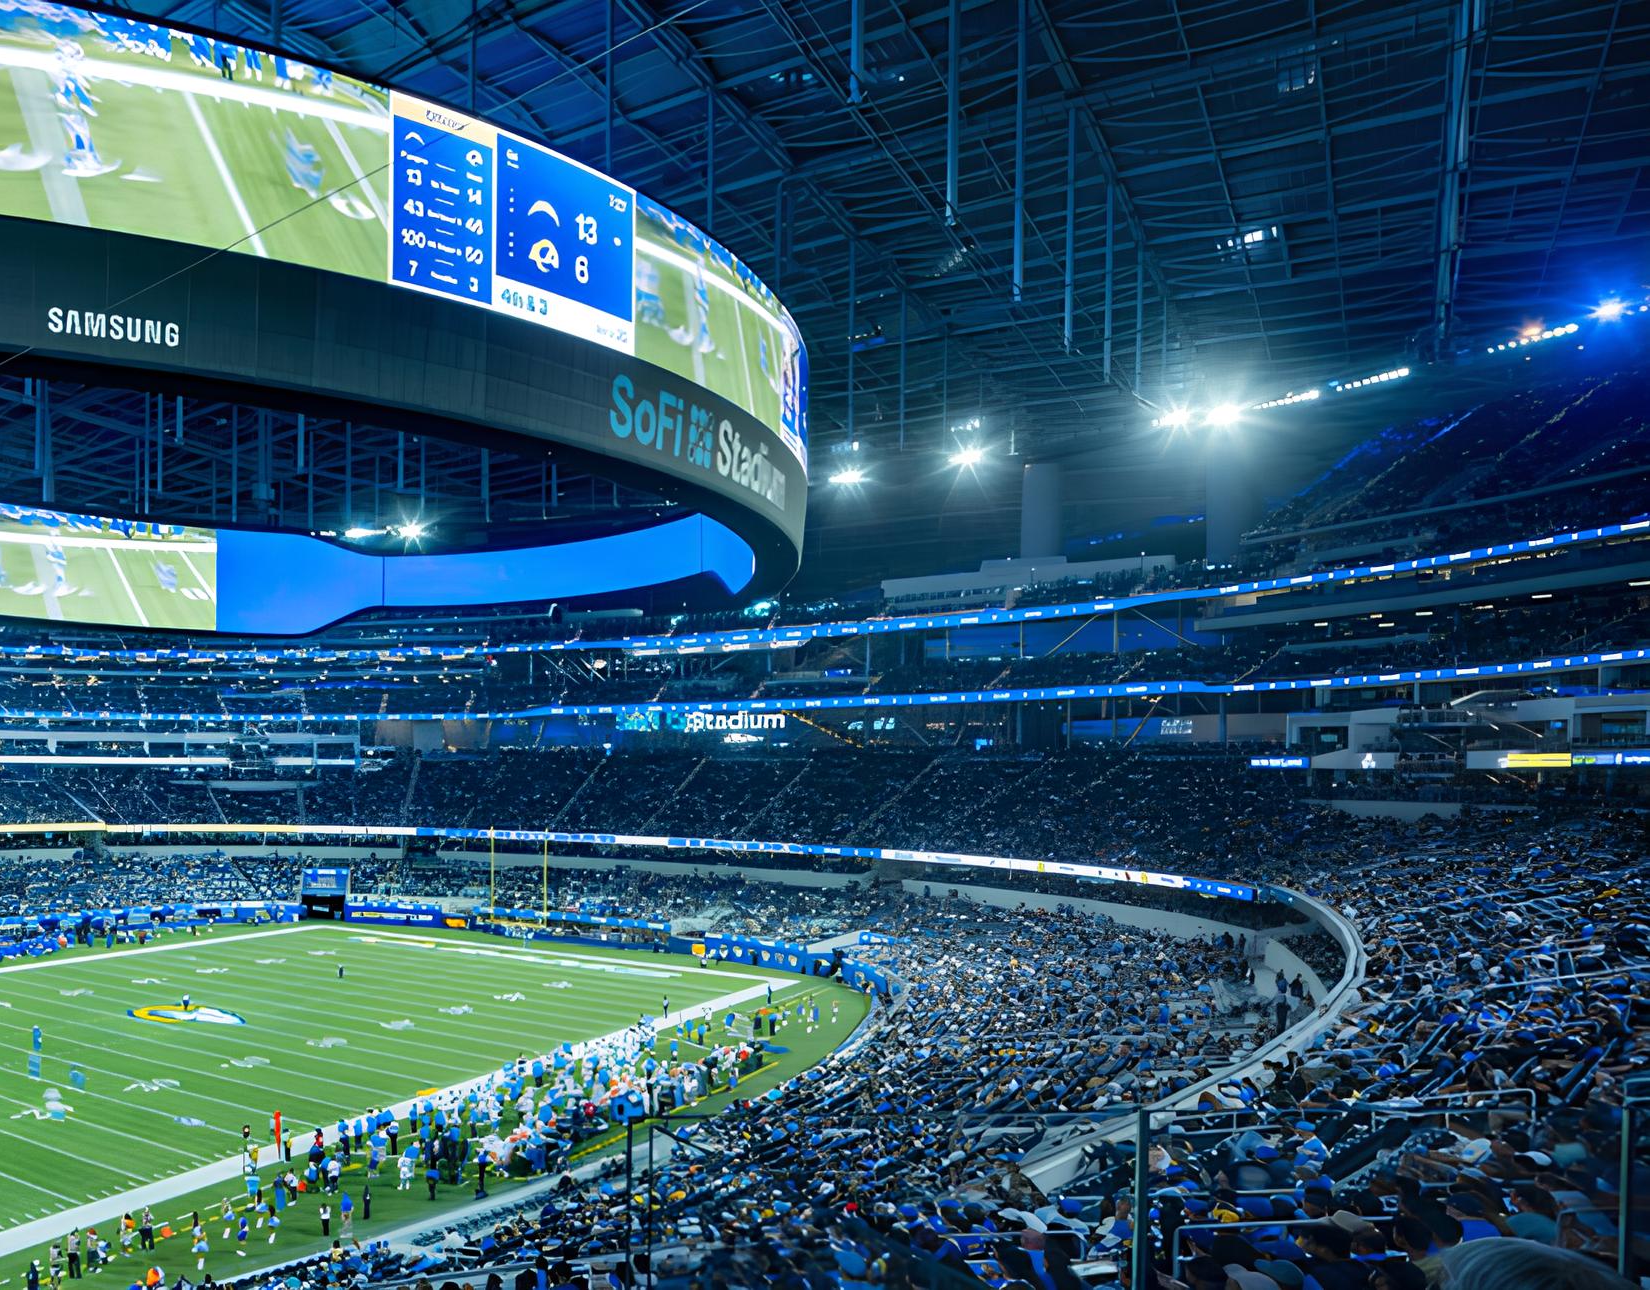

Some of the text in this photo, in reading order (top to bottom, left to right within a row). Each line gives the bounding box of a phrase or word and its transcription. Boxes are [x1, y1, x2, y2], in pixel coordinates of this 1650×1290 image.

[574, 213, 598, 245] 13
[48, 306, 180, 347] SAMSUNG
[609, 374, 684, 457] SoFi
